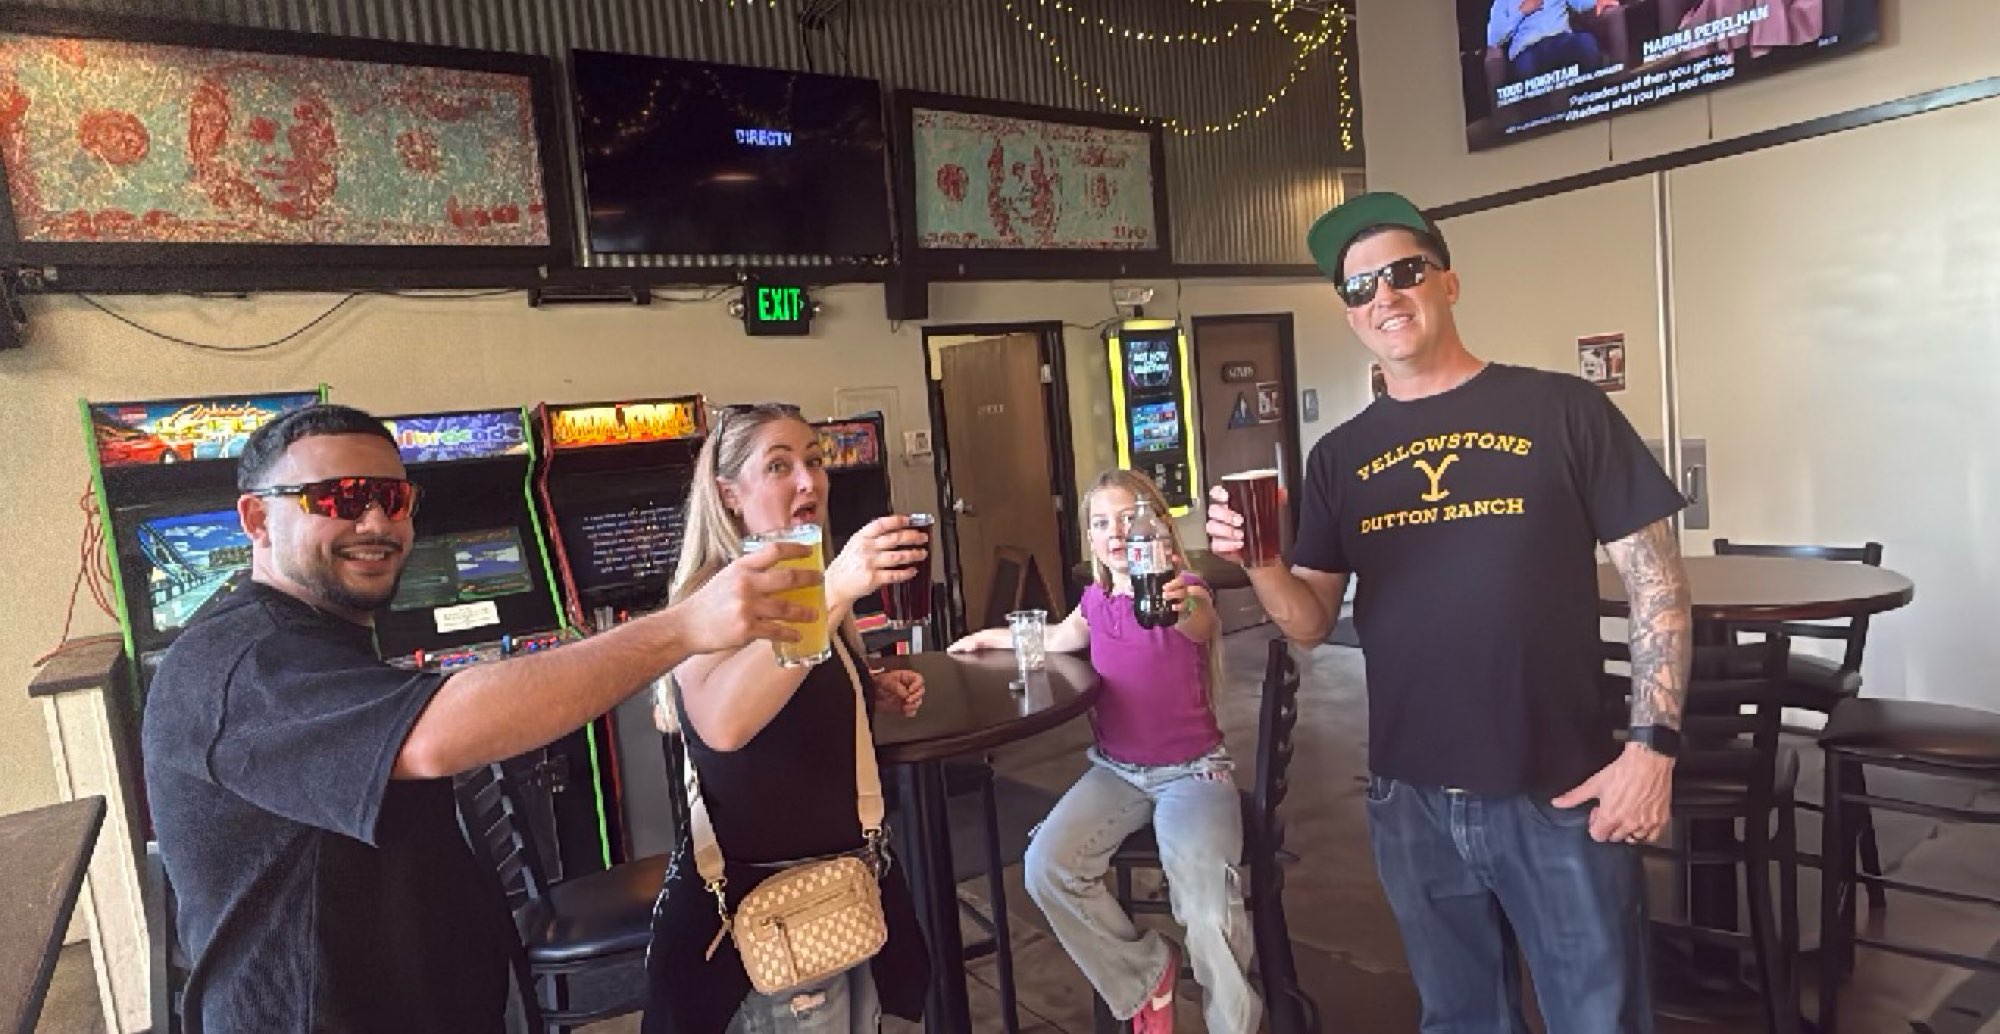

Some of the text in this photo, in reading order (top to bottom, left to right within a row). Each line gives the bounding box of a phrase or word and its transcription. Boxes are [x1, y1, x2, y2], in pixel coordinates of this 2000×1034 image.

[1643, 29, 1692, 55] MARINA
[1694, 5, 1769, 39] PERELMAN
[1622, 76, 1641, 92] and
[1643, 73, 1668, 86] then
[1669, 65, 1691, 80] you
[1693, 57, 1711, 74] get
[1612, 94, 1632, 109] and
[1634, 90, 1653, 105] you
[1655, 82, 1675, 101] just
[1678, 77, 1699, 91] see
[735, 129, 792, 146] DIRECTV
[758, 288, 800, 320] EXIT
[1356, 432, 1531, 480] YELLOWSTONE
[1414, 454, 1459, 501] Y
[1361, 498, 1525, 534] DUTTON RANCH
